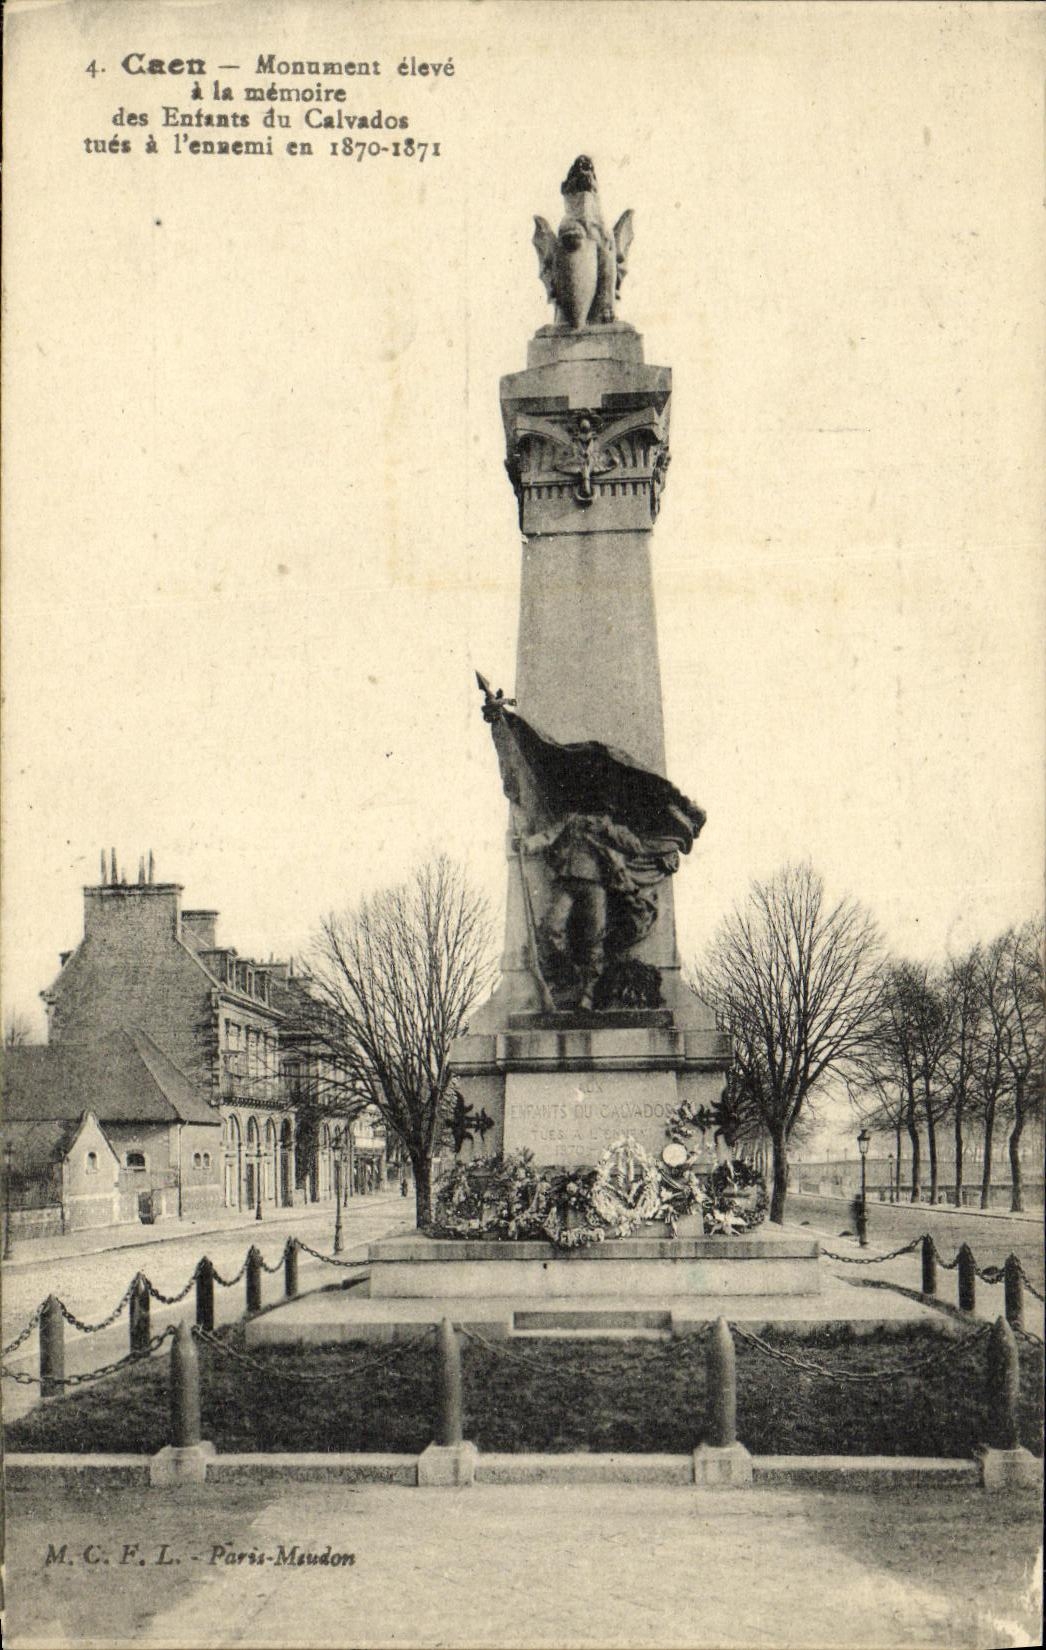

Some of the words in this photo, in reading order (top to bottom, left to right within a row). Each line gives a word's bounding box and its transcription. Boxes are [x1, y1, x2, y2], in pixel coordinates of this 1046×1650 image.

[510, 1103, 568, 1119] ENFANTS
[574, 1103, 594, 1119] DU
[600, 1103, 675, 1119] CALVADOS
